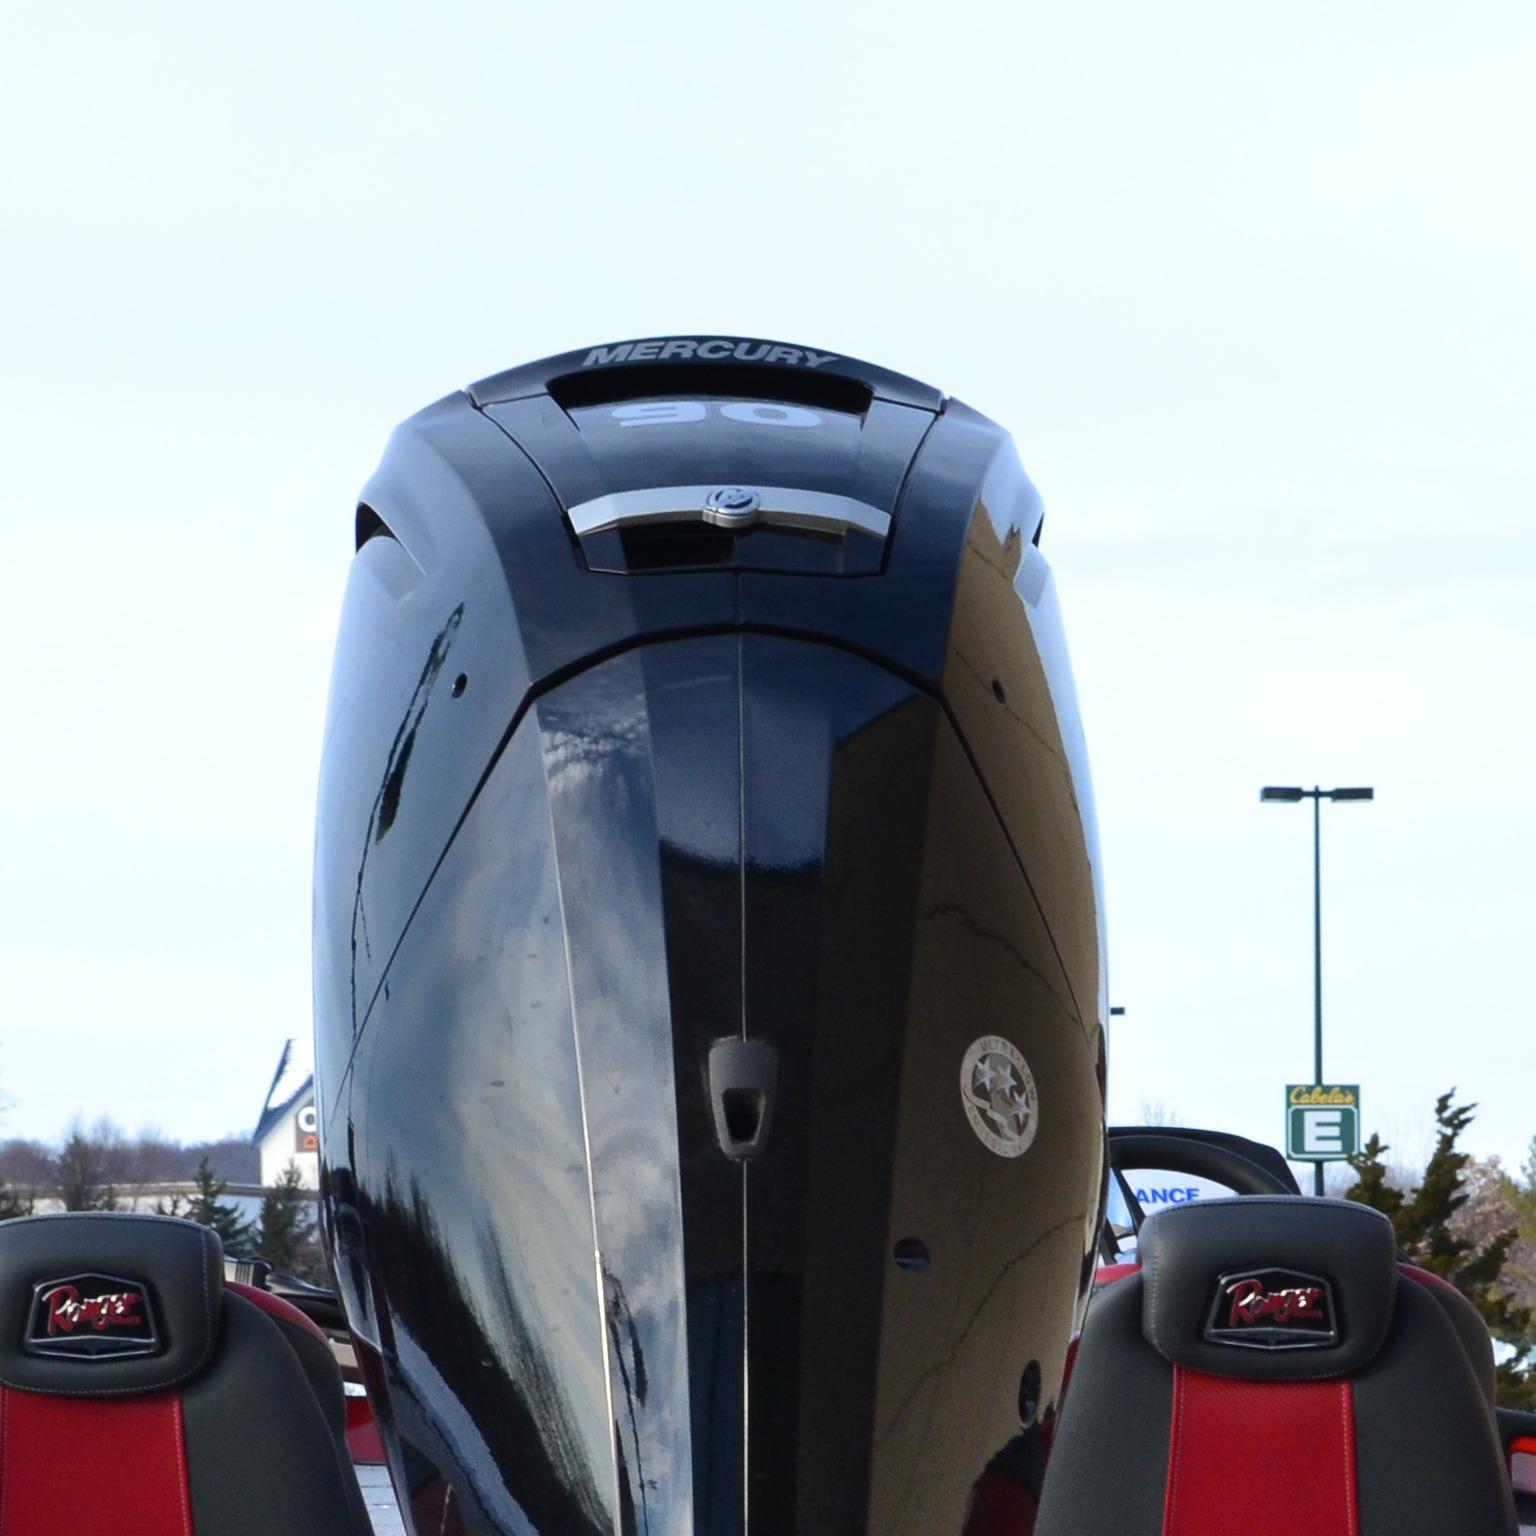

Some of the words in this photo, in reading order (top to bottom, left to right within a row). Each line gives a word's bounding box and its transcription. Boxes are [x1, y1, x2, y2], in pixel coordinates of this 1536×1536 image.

[582, 340, 840, 368] MERCURY
[612, 400, 822, 427] 90
[1304, 1111, 1342, 1152] E
[42, 1285, 144, 1336] Ranger
[1225, 1278, 1324, 1326] Ranger
